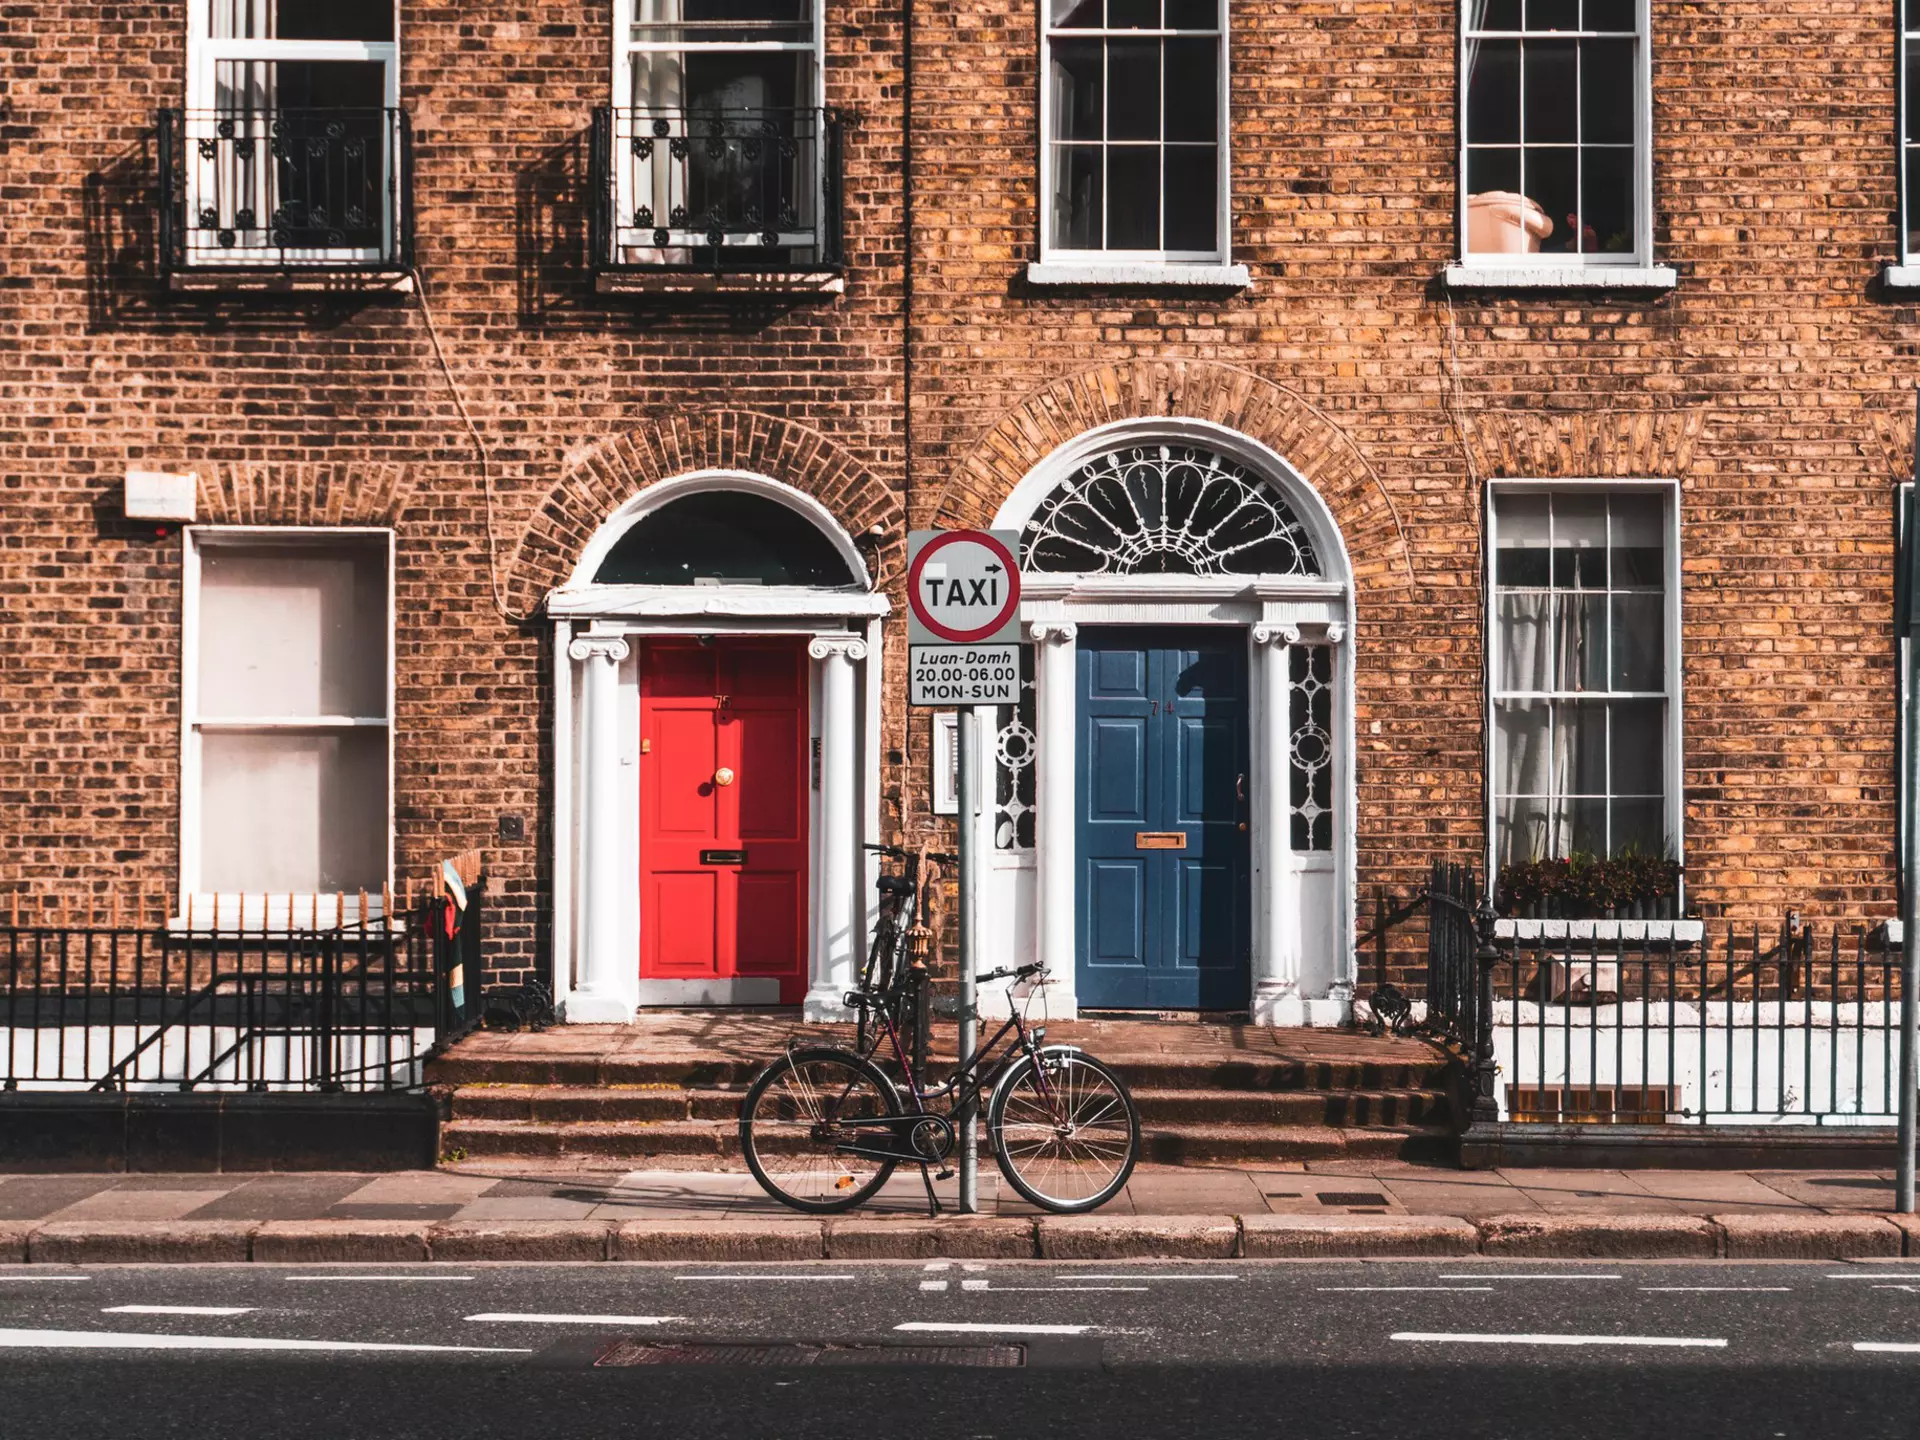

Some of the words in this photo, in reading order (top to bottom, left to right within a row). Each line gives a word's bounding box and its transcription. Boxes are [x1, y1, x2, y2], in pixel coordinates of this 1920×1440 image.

[925, 578, 998, 607] TAXI
[919, 650, 1012, 665] Luan-Domh
[915, 667, 1015, 682] 20.00-06.00
[922, 684, 1010, 699] MON-SUN
[1150, 700, 1175, 715] 74
